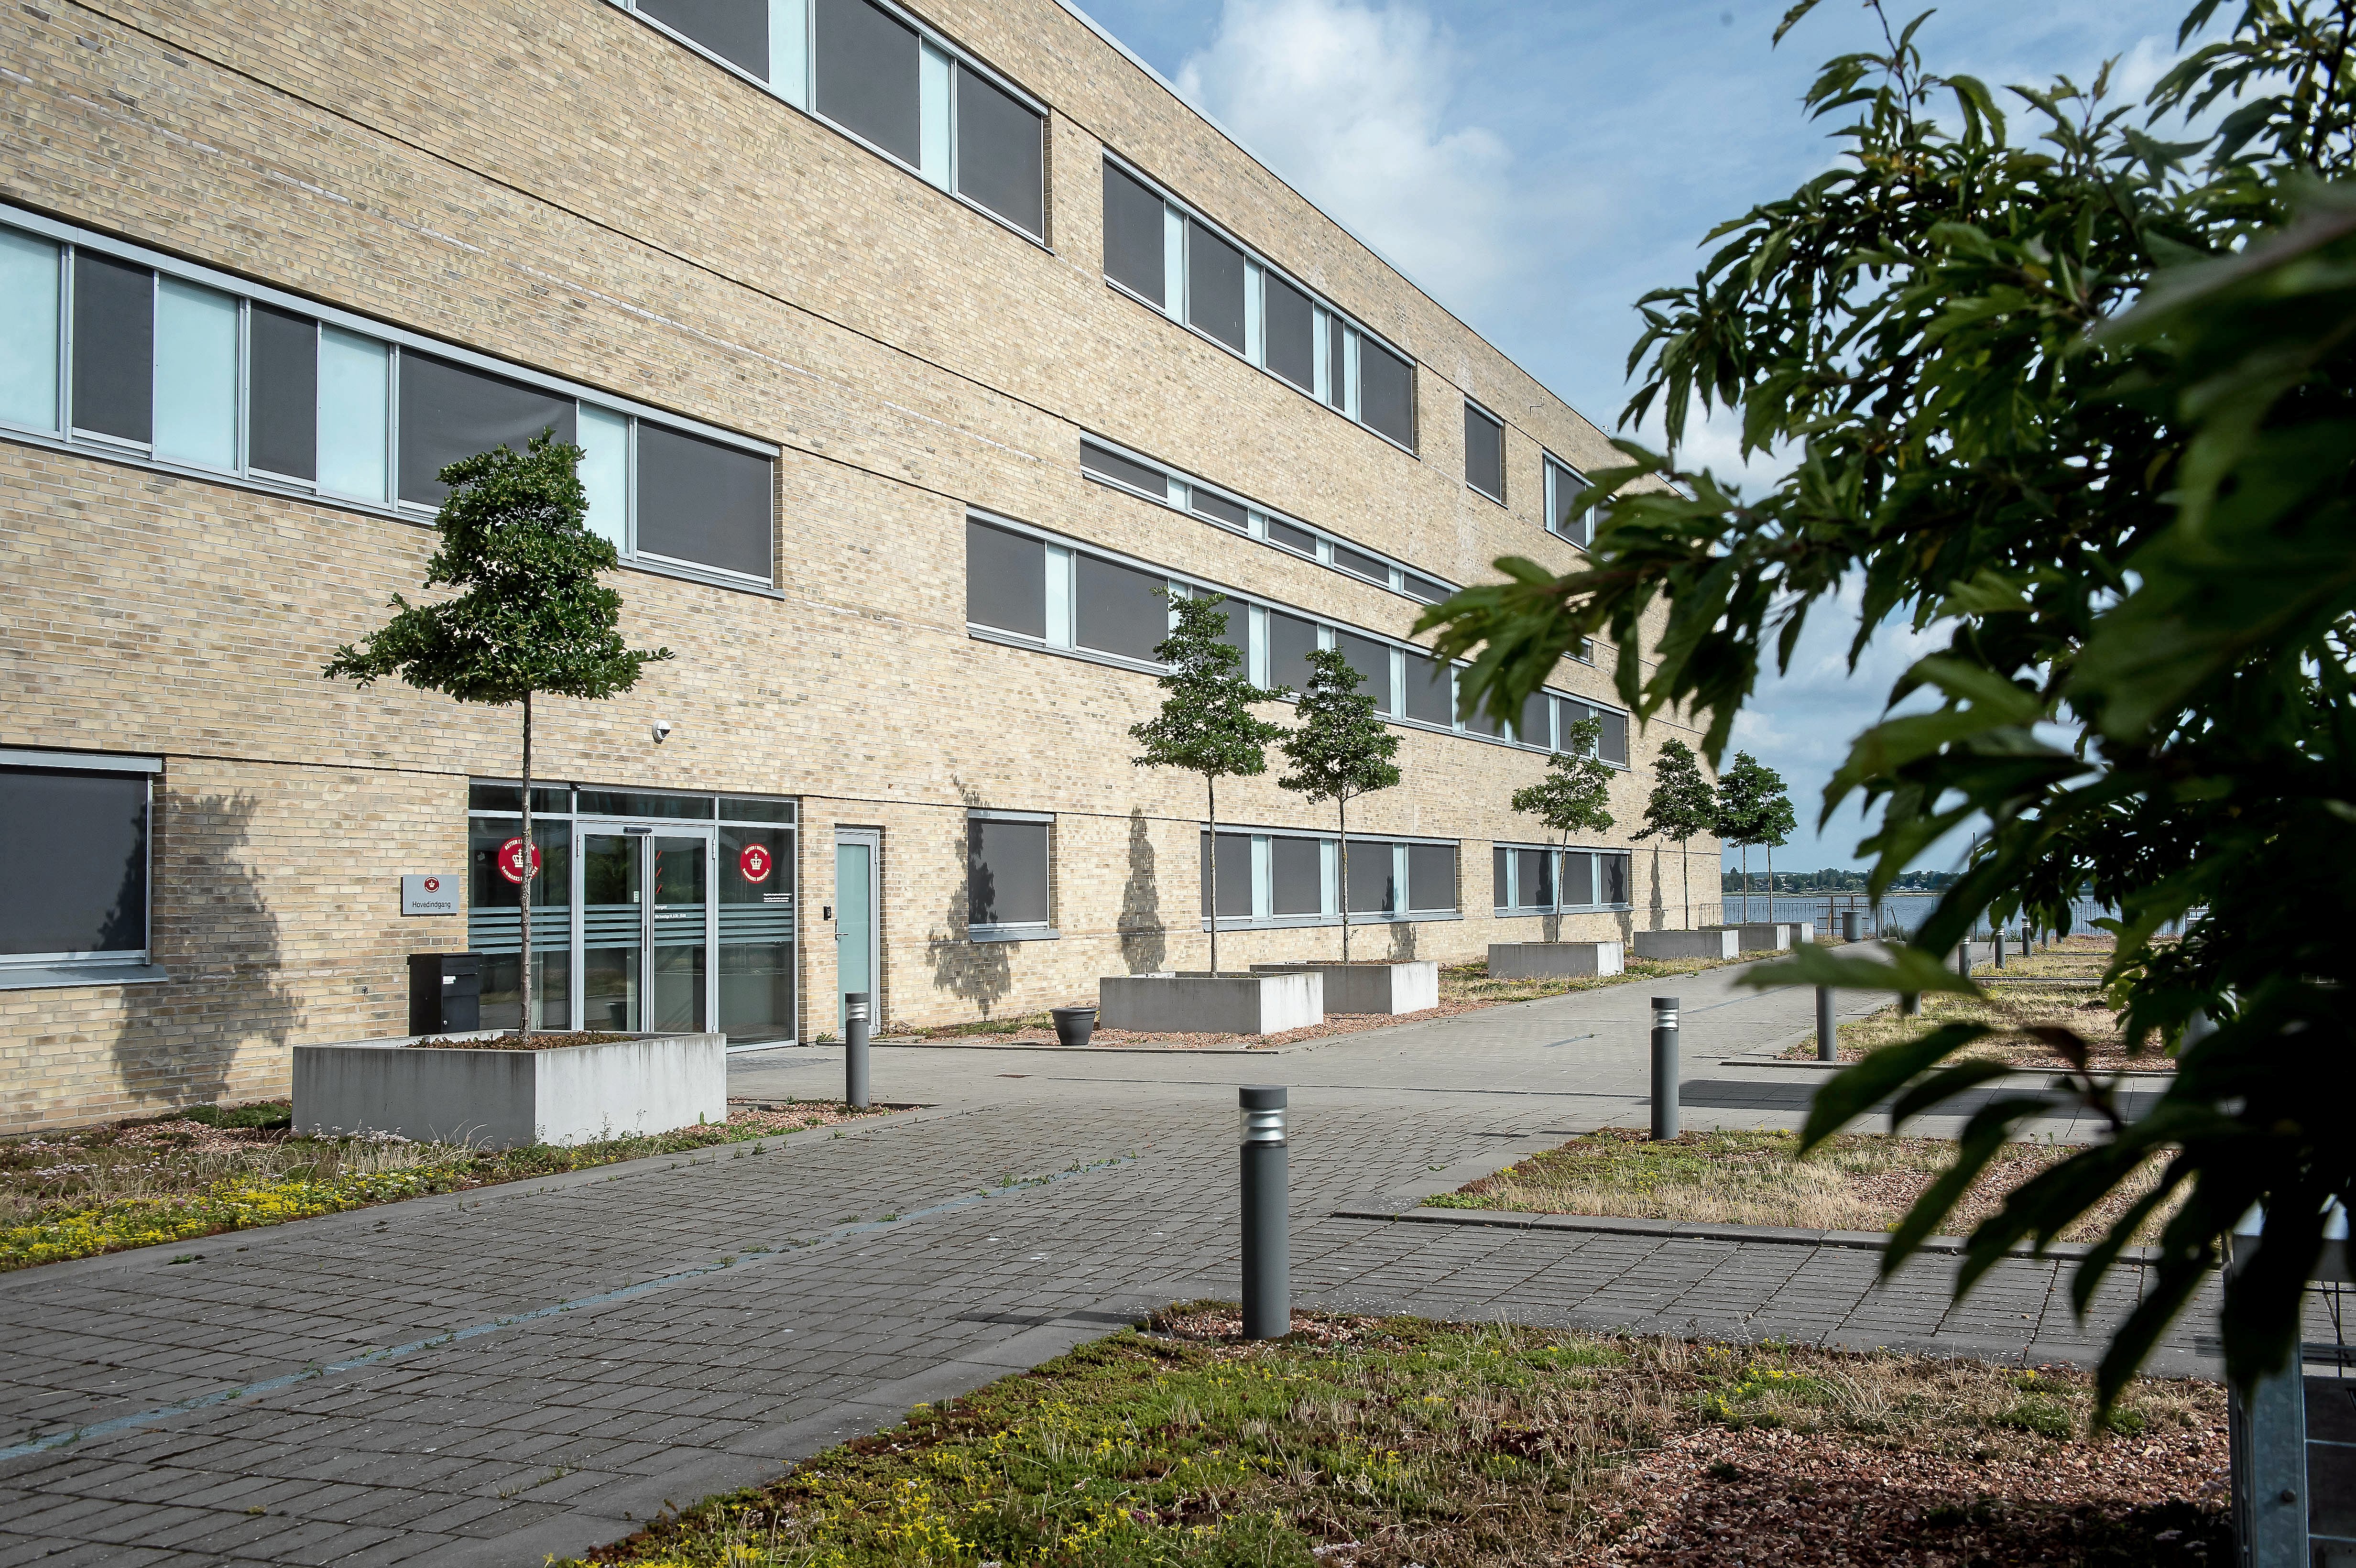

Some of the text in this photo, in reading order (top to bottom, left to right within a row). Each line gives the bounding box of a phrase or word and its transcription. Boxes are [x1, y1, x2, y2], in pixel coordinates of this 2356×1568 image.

[504, 839, 518, 850] RETTEN
[502, 865, 520, 882] DANMARKS
[412, 901, 451, 909] Hovedindgang
